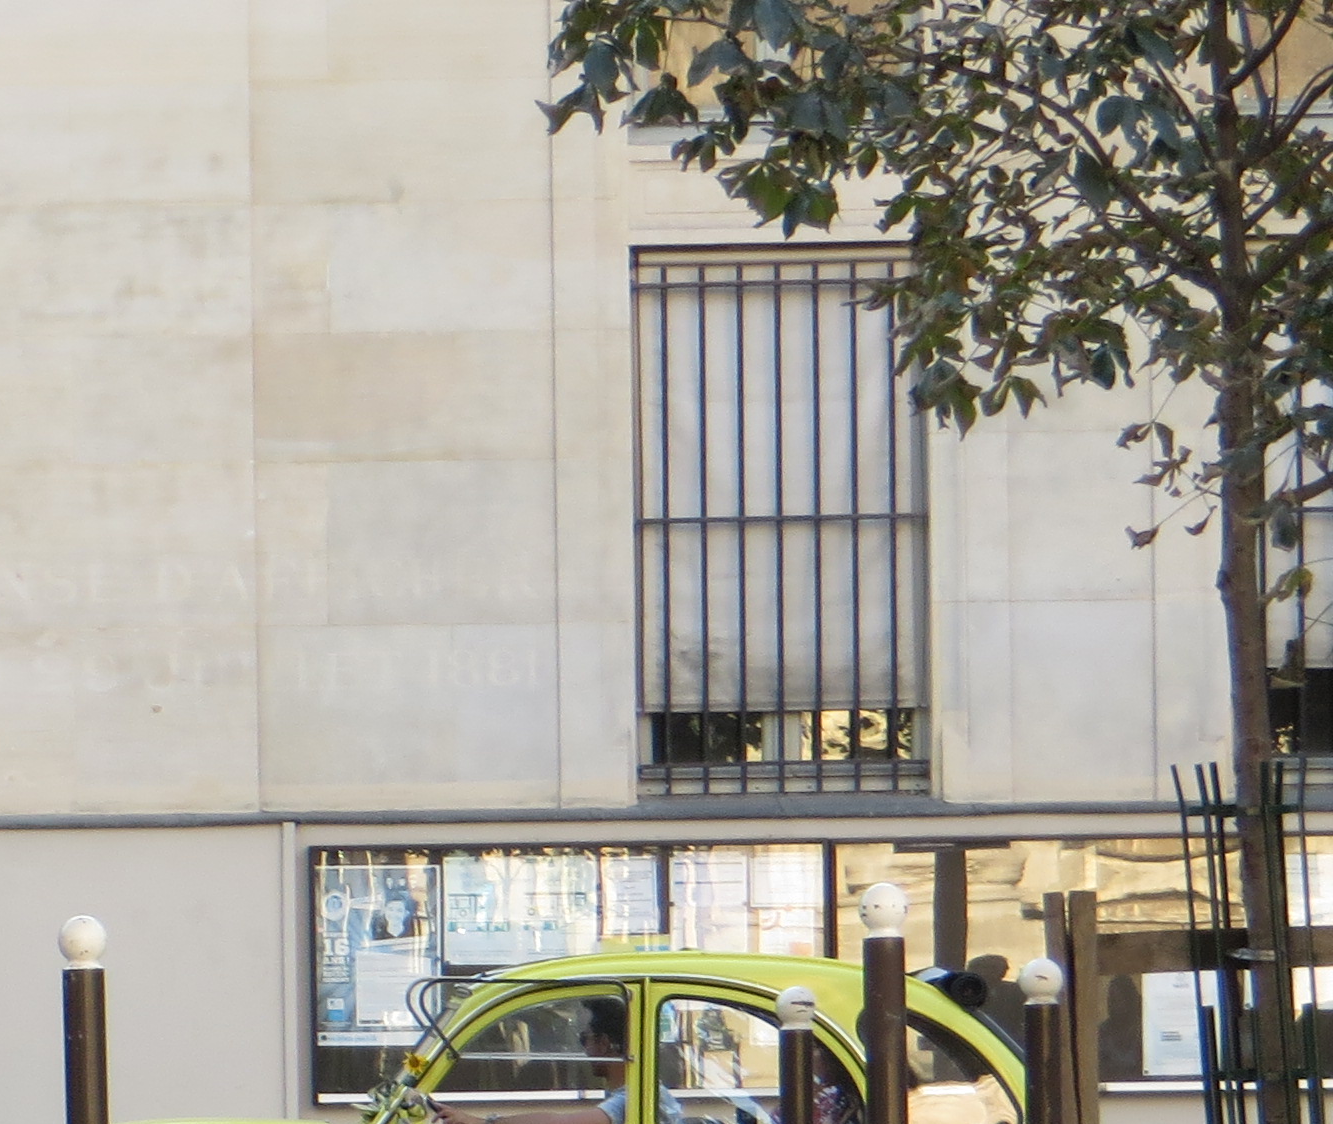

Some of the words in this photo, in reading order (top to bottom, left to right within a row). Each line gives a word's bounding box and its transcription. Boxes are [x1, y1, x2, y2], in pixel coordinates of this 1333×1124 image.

[145, 648, 404, 693] JULET
[426, 647, 541, 690] 1881
[323, 938, 350, 956] 16
